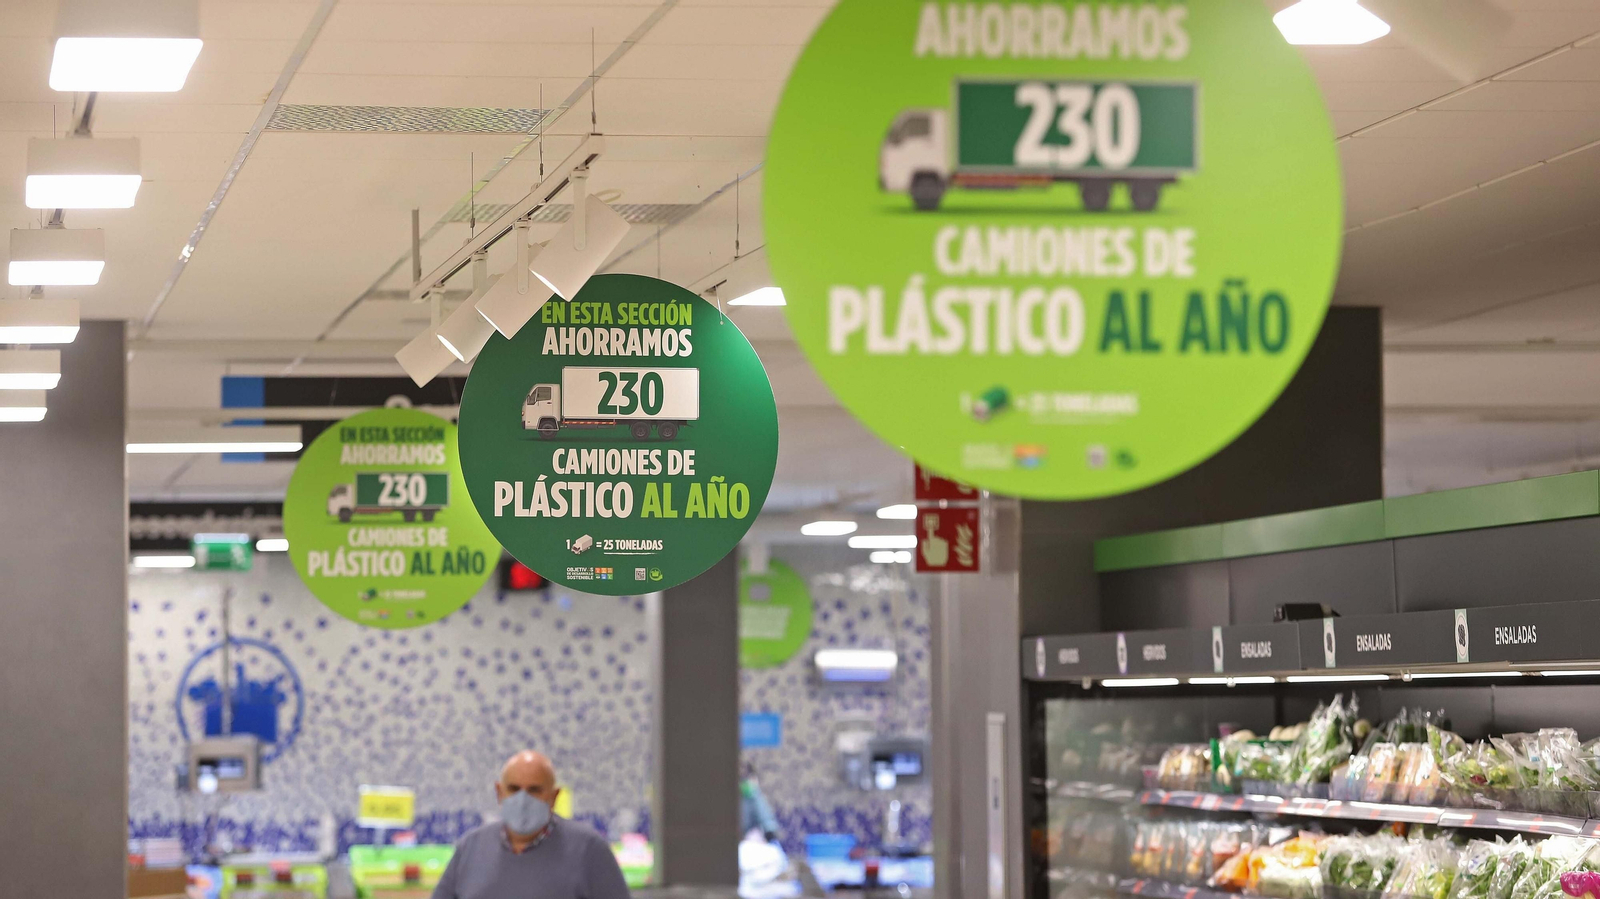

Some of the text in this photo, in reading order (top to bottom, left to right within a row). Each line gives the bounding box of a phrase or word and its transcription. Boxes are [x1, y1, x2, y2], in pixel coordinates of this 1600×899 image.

[914, 3, 1190, 61] AHORRAMOS
[1012, 82, 1142, 170] 230
[935, 225, 1197, 279] CAMIONES DE
[541, 299, 693, 326] EN ESTA SECCIÓN
[828, 273, 1292, 356] PLÁSTICO AL AÑO
[541, 326, 693, 357] AHORRAMOS
[598, 371, 664, 416] 230
[340, 425, 445, 443] EN ESTA SECCIÓN
[340, 443, 446, 465] AHORRAMOS
[552, 448, 696, 476] CAMIONES DE
[378, 473, 428, 507] 230
[494, 474, 750, 519] PLÁSTICO AL AÑO
[348, 527, 448, 547] CAMIONES DE
[565, 539, 571, 550] 1
[603, 539, 614, 550] 25
[615, 539, 663, 551] TONELADAS
[307, 545, 486, 577] PLÁSTICO AL AÑO
[1356, 632, 1392, 652] ENSALADAS
[1495, 624, 1538, 645] ENSALADAS
[1241, 640, 1272, 659] ENSALADAS
